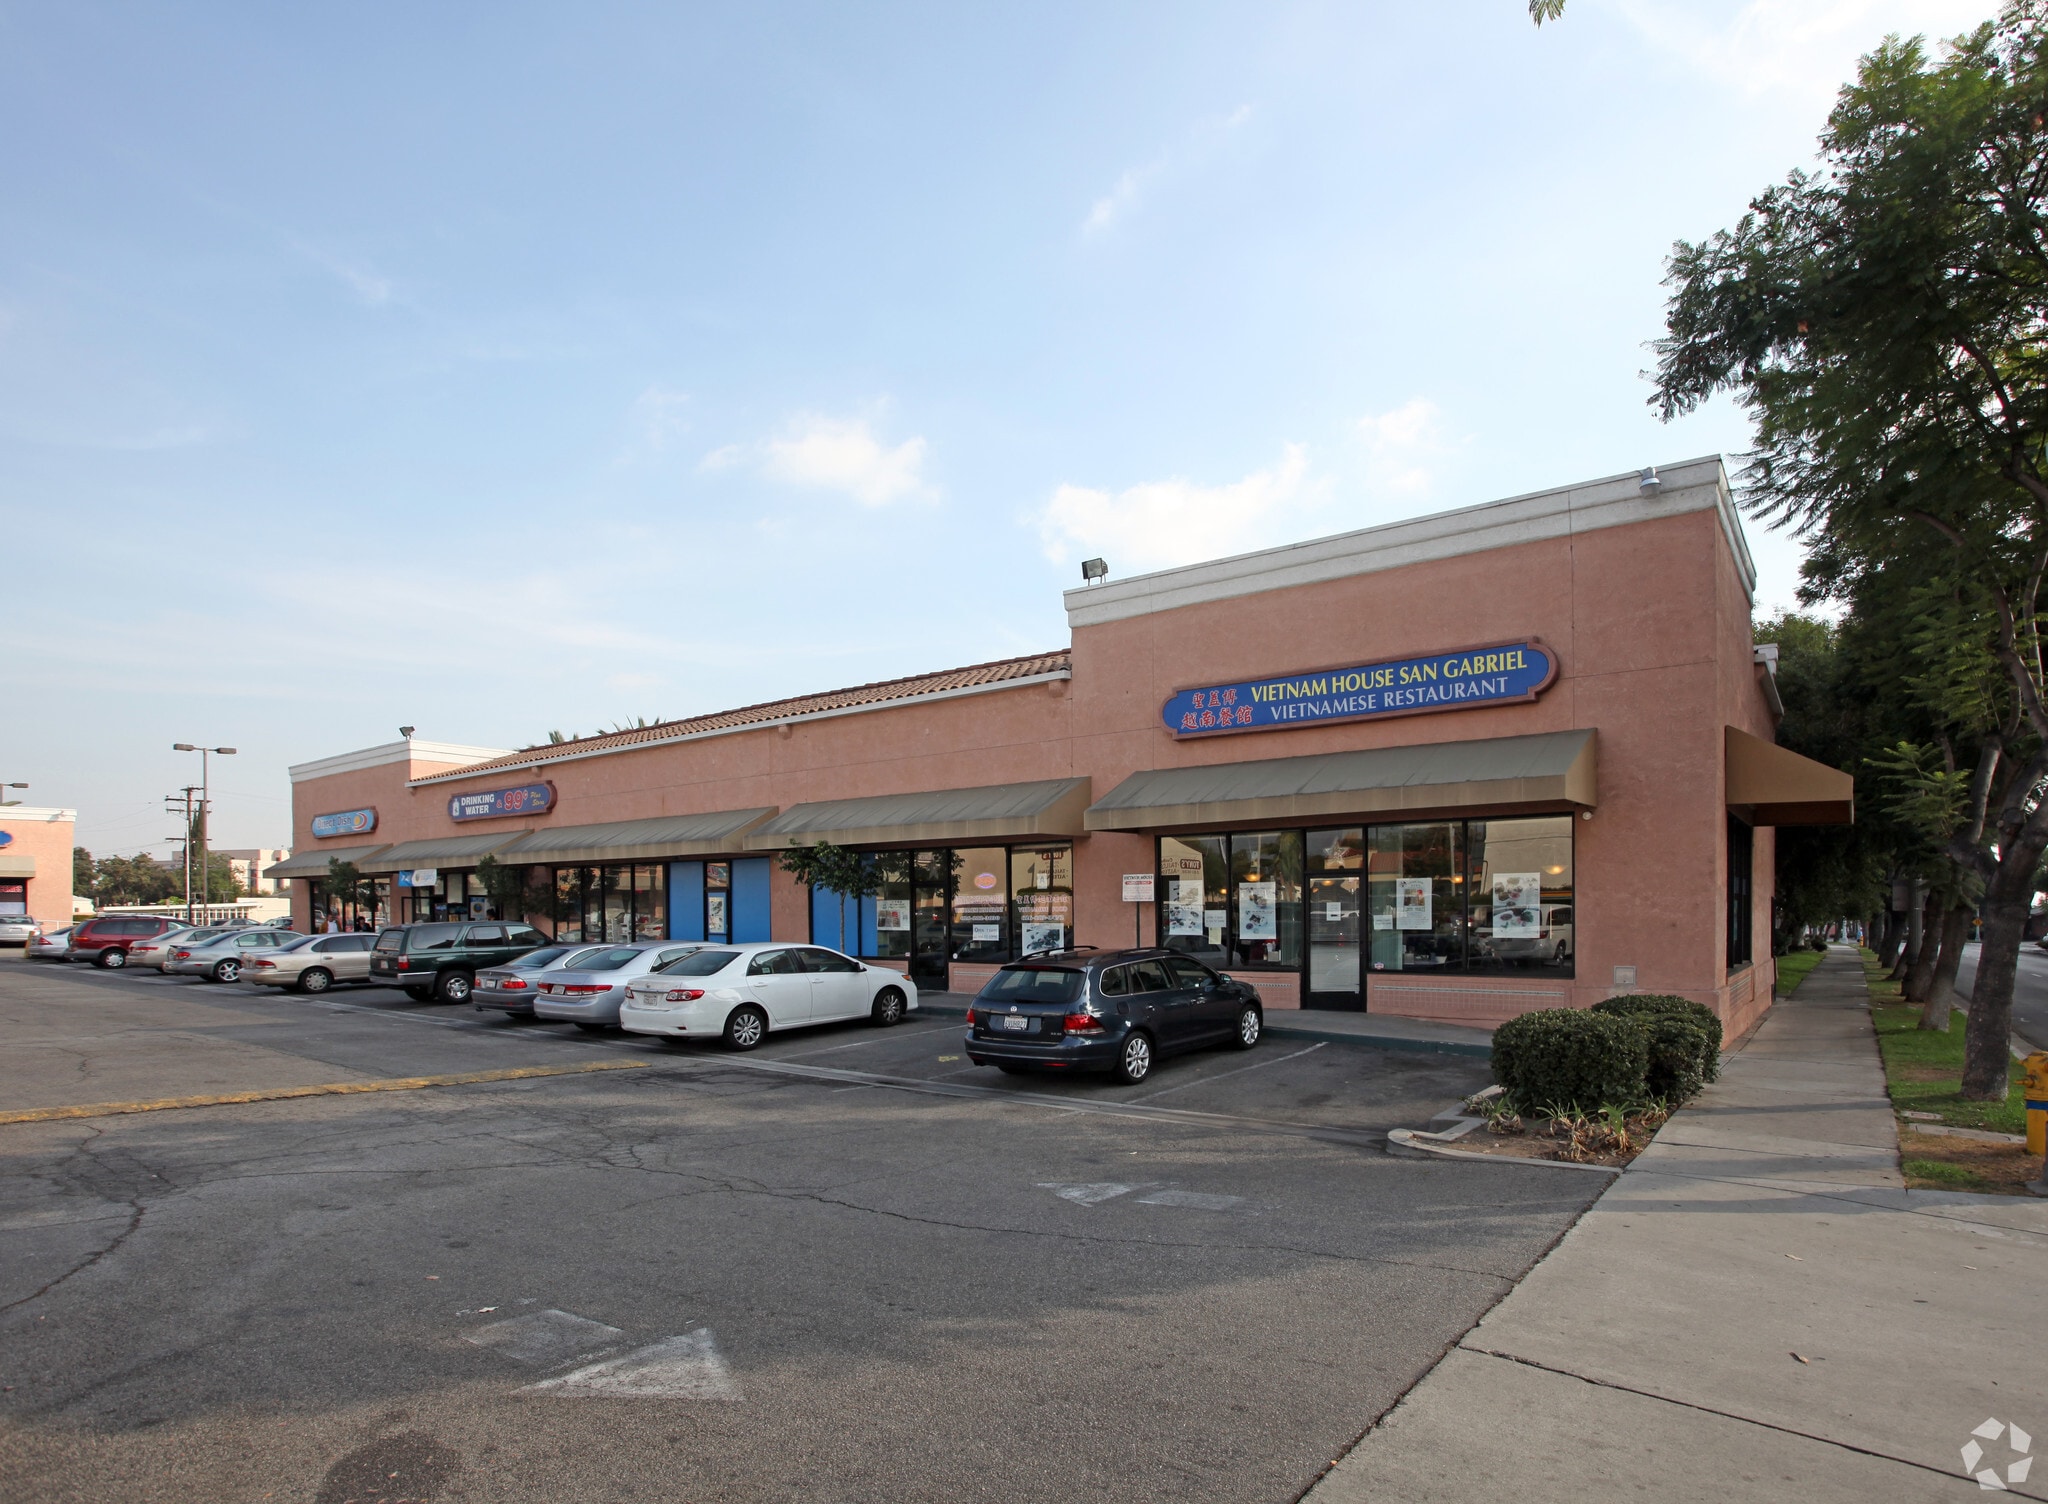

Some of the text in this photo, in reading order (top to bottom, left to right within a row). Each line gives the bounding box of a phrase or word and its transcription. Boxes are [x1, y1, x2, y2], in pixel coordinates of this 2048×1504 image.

[1251, 650, 1527, 702] VIETNAM HOUSE SAN GABRIEL
[1192, 689, 1237, 708] 聖蓋博
[1271, 677, 1508, 720] VIETNAMESE RESTAURANT
[1181, 705, 1253, 729] 越南餐館
[461, 794, 495, 806] DRINKING
[465, 804, 489, 816] WATER
